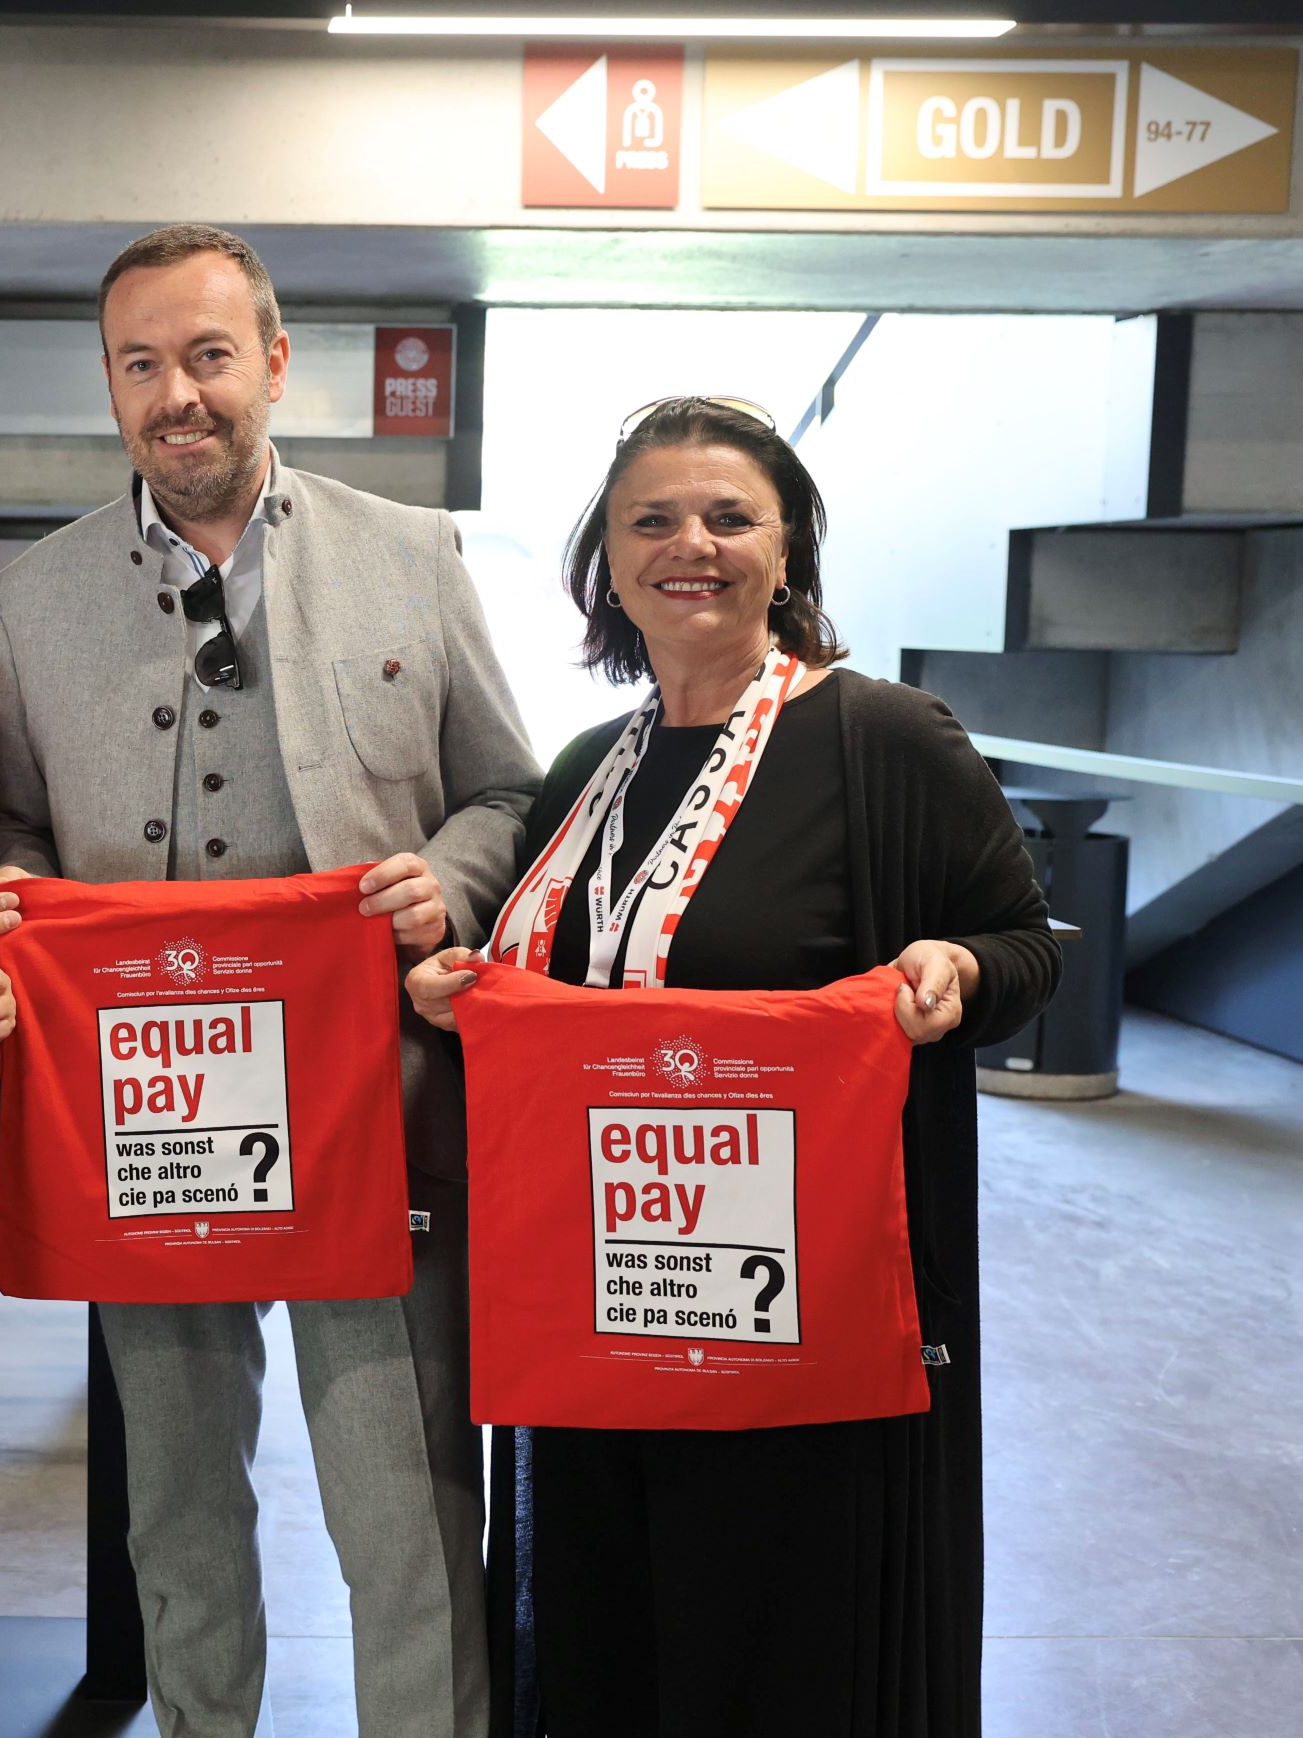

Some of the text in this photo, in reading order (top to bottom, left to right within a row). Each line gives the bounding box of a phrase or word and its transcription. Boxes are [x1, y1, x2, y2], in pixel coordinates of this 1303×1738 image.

[915, 95, 1082, 160] GOLD
[1146, 121, 1212, 142] 94-77
[385, 378, 438, 398] PRESS
[386, 398, 435, 417] GUEST
[253, 959, 283, 967] opportunità
[109, 1006, 252, 1068] equal
[592, 1063, 645, 1071] Chancengleichheit
[759, 1065, 795, 1073] opportunità
[113, 1073, 205, 1125] pay
[608, 1090, 640, 1098] Comisciun
[116, 1137, 214, 1157] was sonst
[601, 1113, 759, 1176] equal
[117, 1162, 201, 1181] che altro
[239, 1132, 280, 1202] ?
[119, 1183, 238, 1208] cie pa scenó
[604, 1182, 706, 1235] pay
[606, 1253, 712, 1273] was sonst
[606, 1276, 698, 1299] che altro
[740, 1254, 785, 1333] ?
[607, 1304, 737, 1329] cie pa scenó
